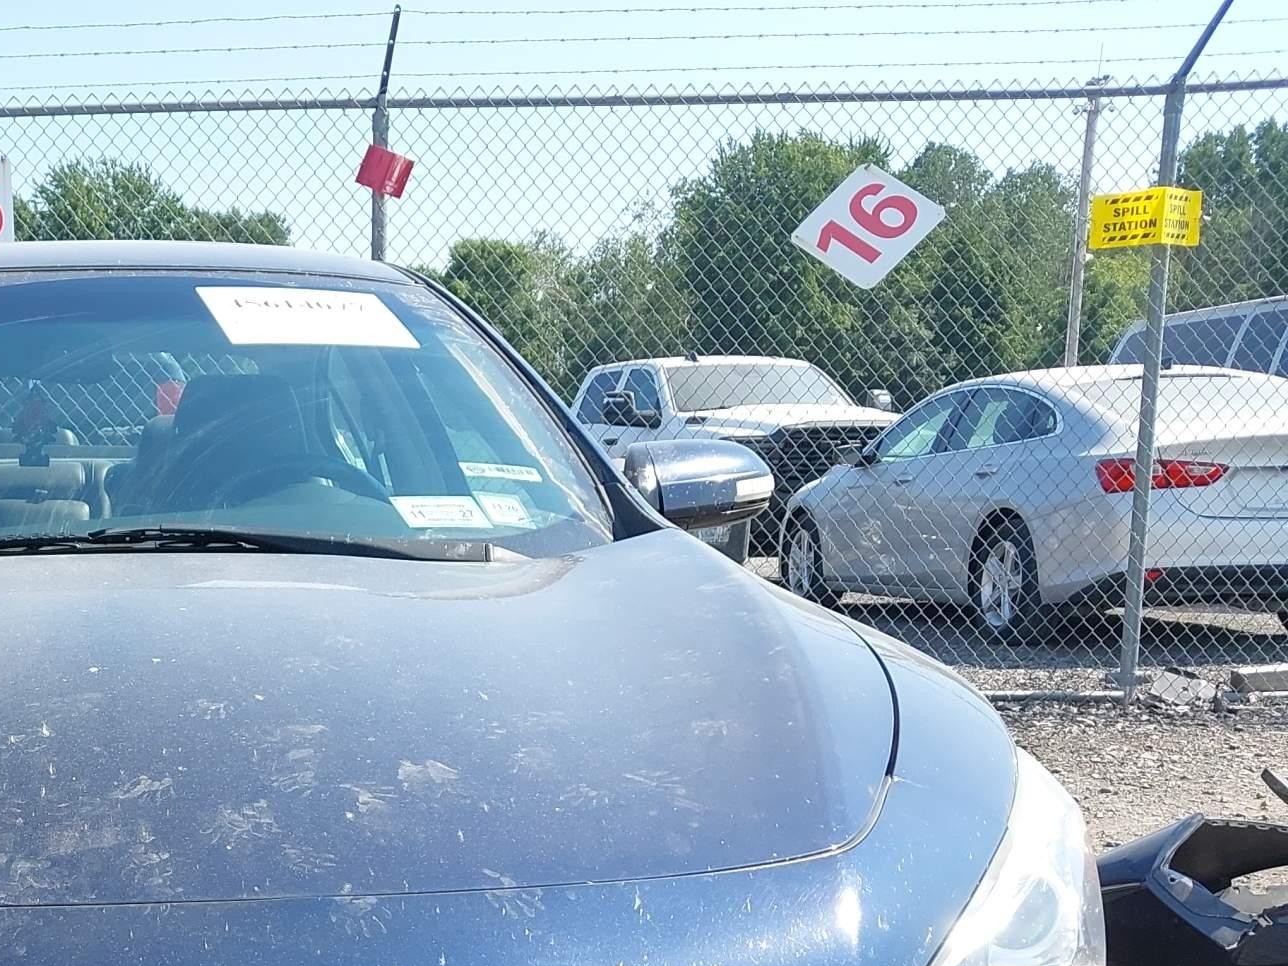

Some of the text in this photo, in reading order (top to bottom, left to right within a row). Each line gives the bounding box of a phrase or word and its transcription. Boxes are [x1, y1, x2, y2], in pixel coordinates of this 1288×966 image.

[1113, 205, 1150, 218] SPILL
[1169, 203, 1187, 216] SPILL
[816, 183, 918, 265] 16
[1103, 218, 1158, 233] STATION
[1164, 218, 1190, 231] STATION
